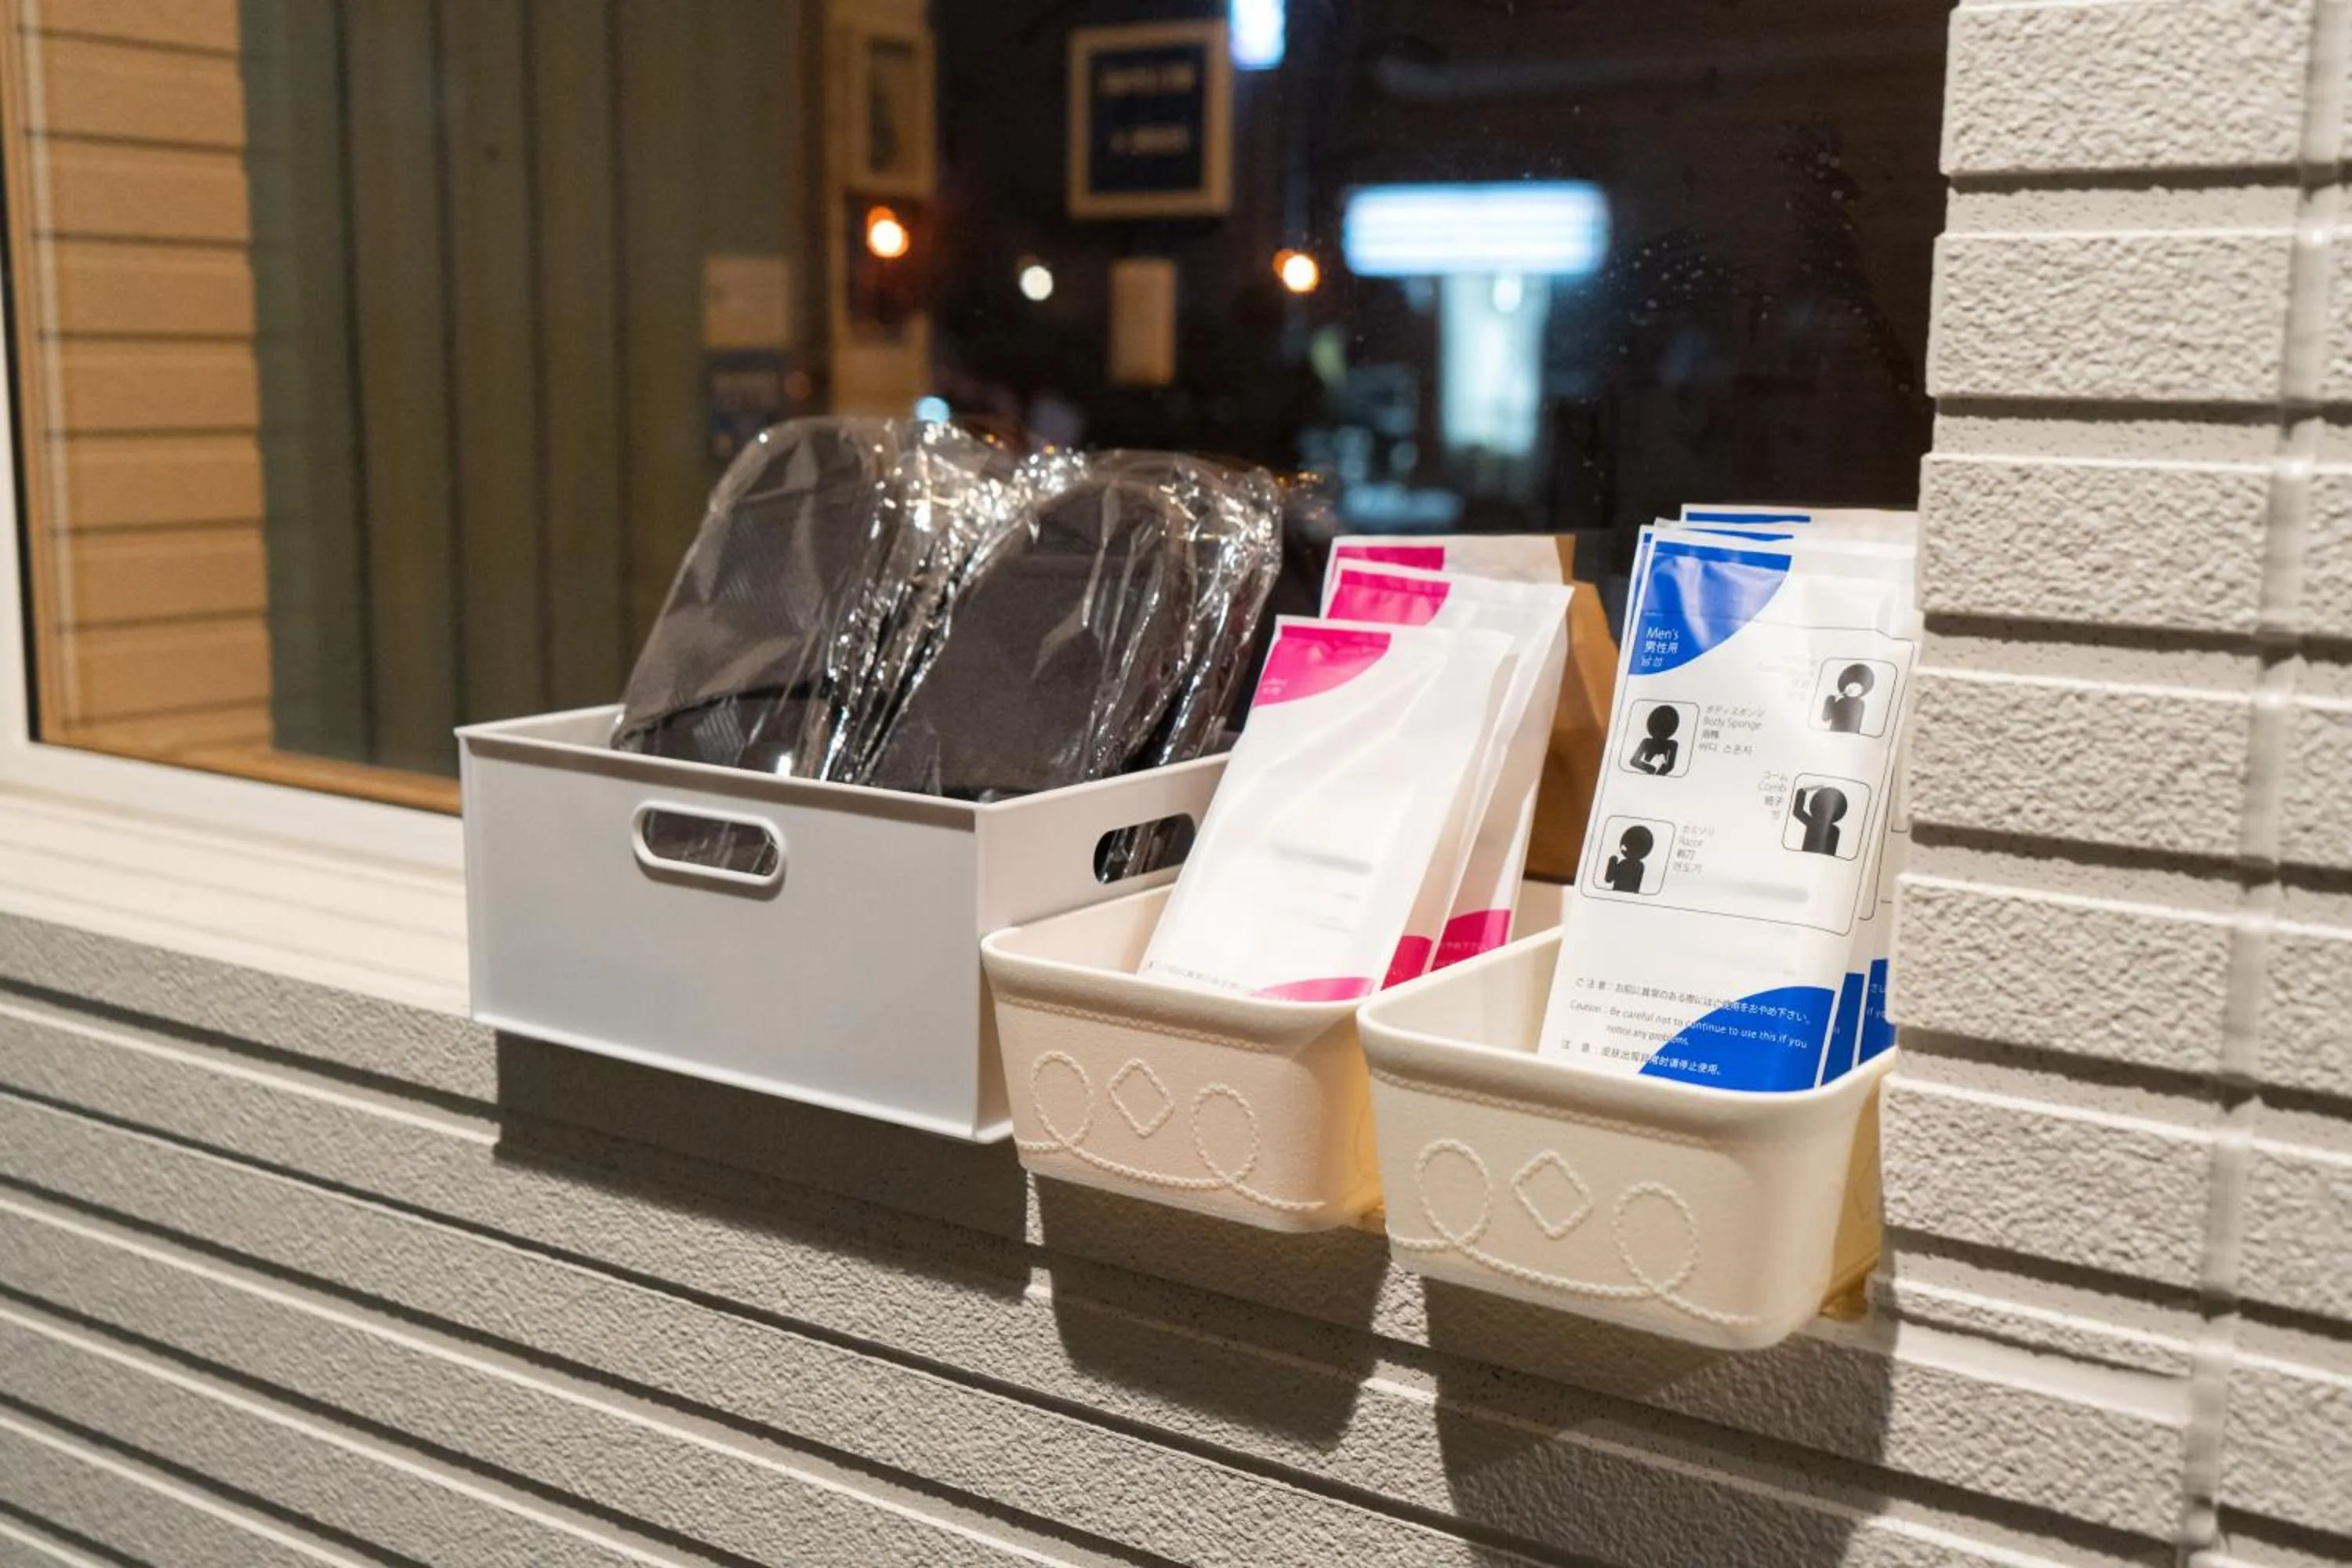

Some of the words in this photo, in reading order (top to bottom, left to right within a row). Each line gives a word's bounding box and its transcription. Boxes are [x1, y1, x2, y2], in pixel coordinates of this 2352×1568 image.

[1646, 626, 1679, 641] Men's
[1643, 641, 1679, 654] 男性用
[1757, 780, 1787, 792] Comb
[1610, 1005, 1621, 1017] Be
[1623, 1008, 1655, 1022] careful
[1655, 1015, 1671, 1025] not
[1674, 1017, 1683, 1026] to
[1686, 1019, 1727, 1034] continue
[1729, 1025, 1739, 1036] to
[1740, 1028, 1758, 1039] use
[1759, 1029, 1777, 1041] this
[1779, 1033, 1788, 1044] if
[1788, 1036, 1808, 1049] you
[1634, 1029, 1646, 1040] any
